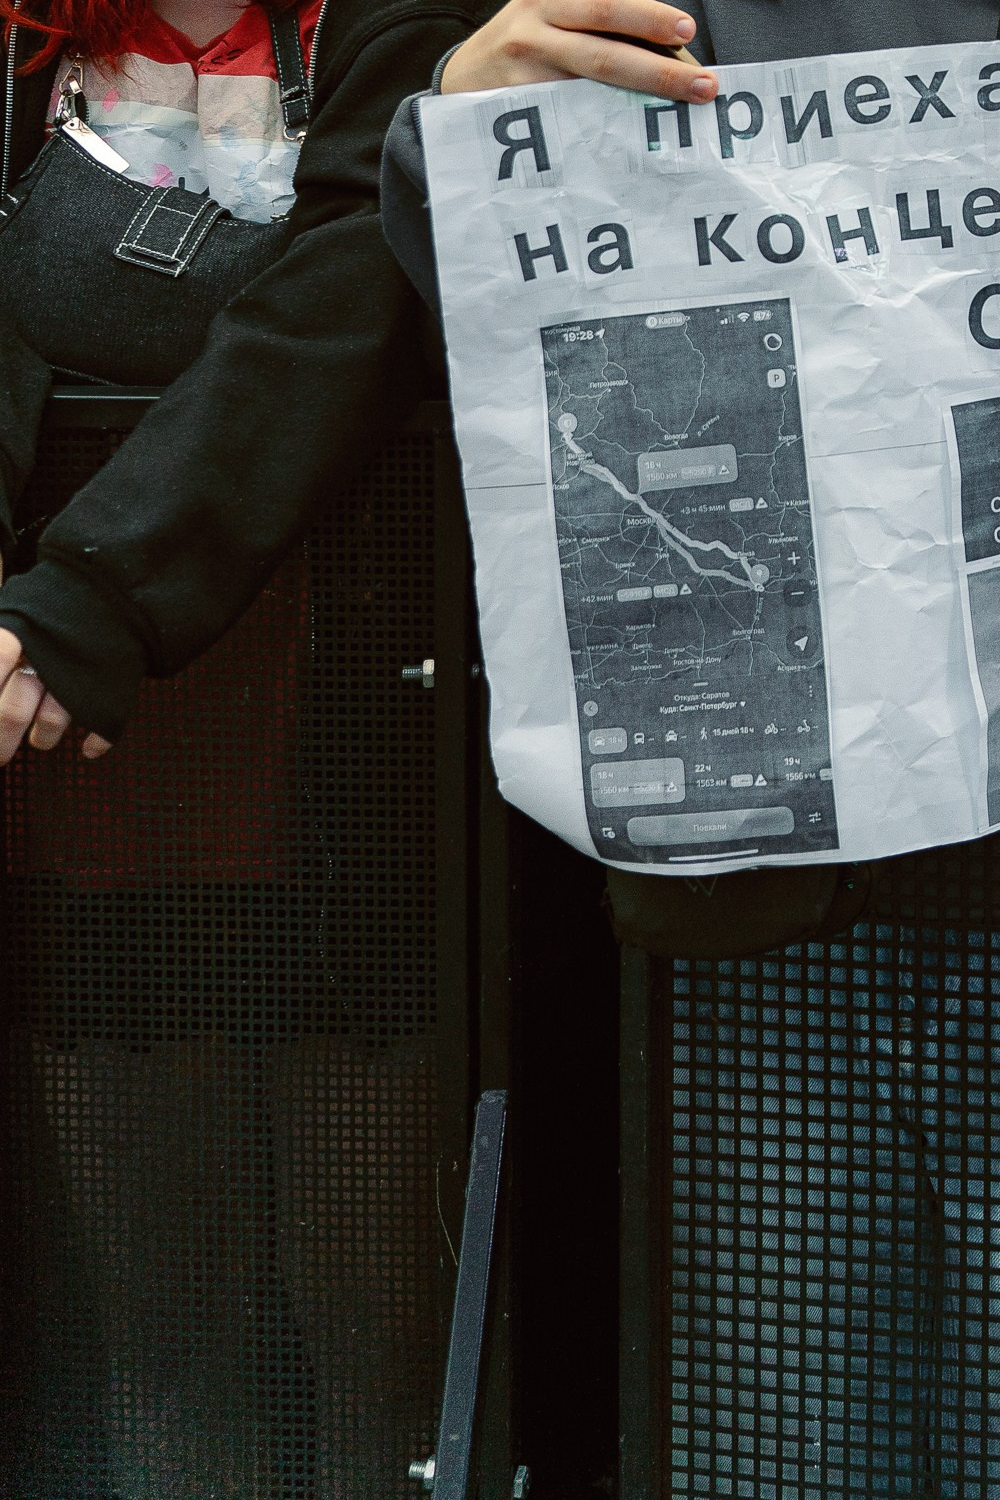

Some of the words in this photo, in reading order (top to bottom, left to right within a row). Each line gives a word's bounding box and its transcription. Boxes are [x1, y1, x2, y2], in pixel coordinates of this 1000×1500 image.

[492, 105, 552, 181] Я
[514, 220, 634, 282] на
[658, 316, 683, 325] Карты
[563, 330, 594, 343] 19:28
[674, 692, 701, 702] Откуда:
[701, 691, 730, 701] Саратов
[660, 705, 679, 715] Куда:
[679, 701, 738, 713] Санкт-Петербург
[694, 764, 705, 773] 22
